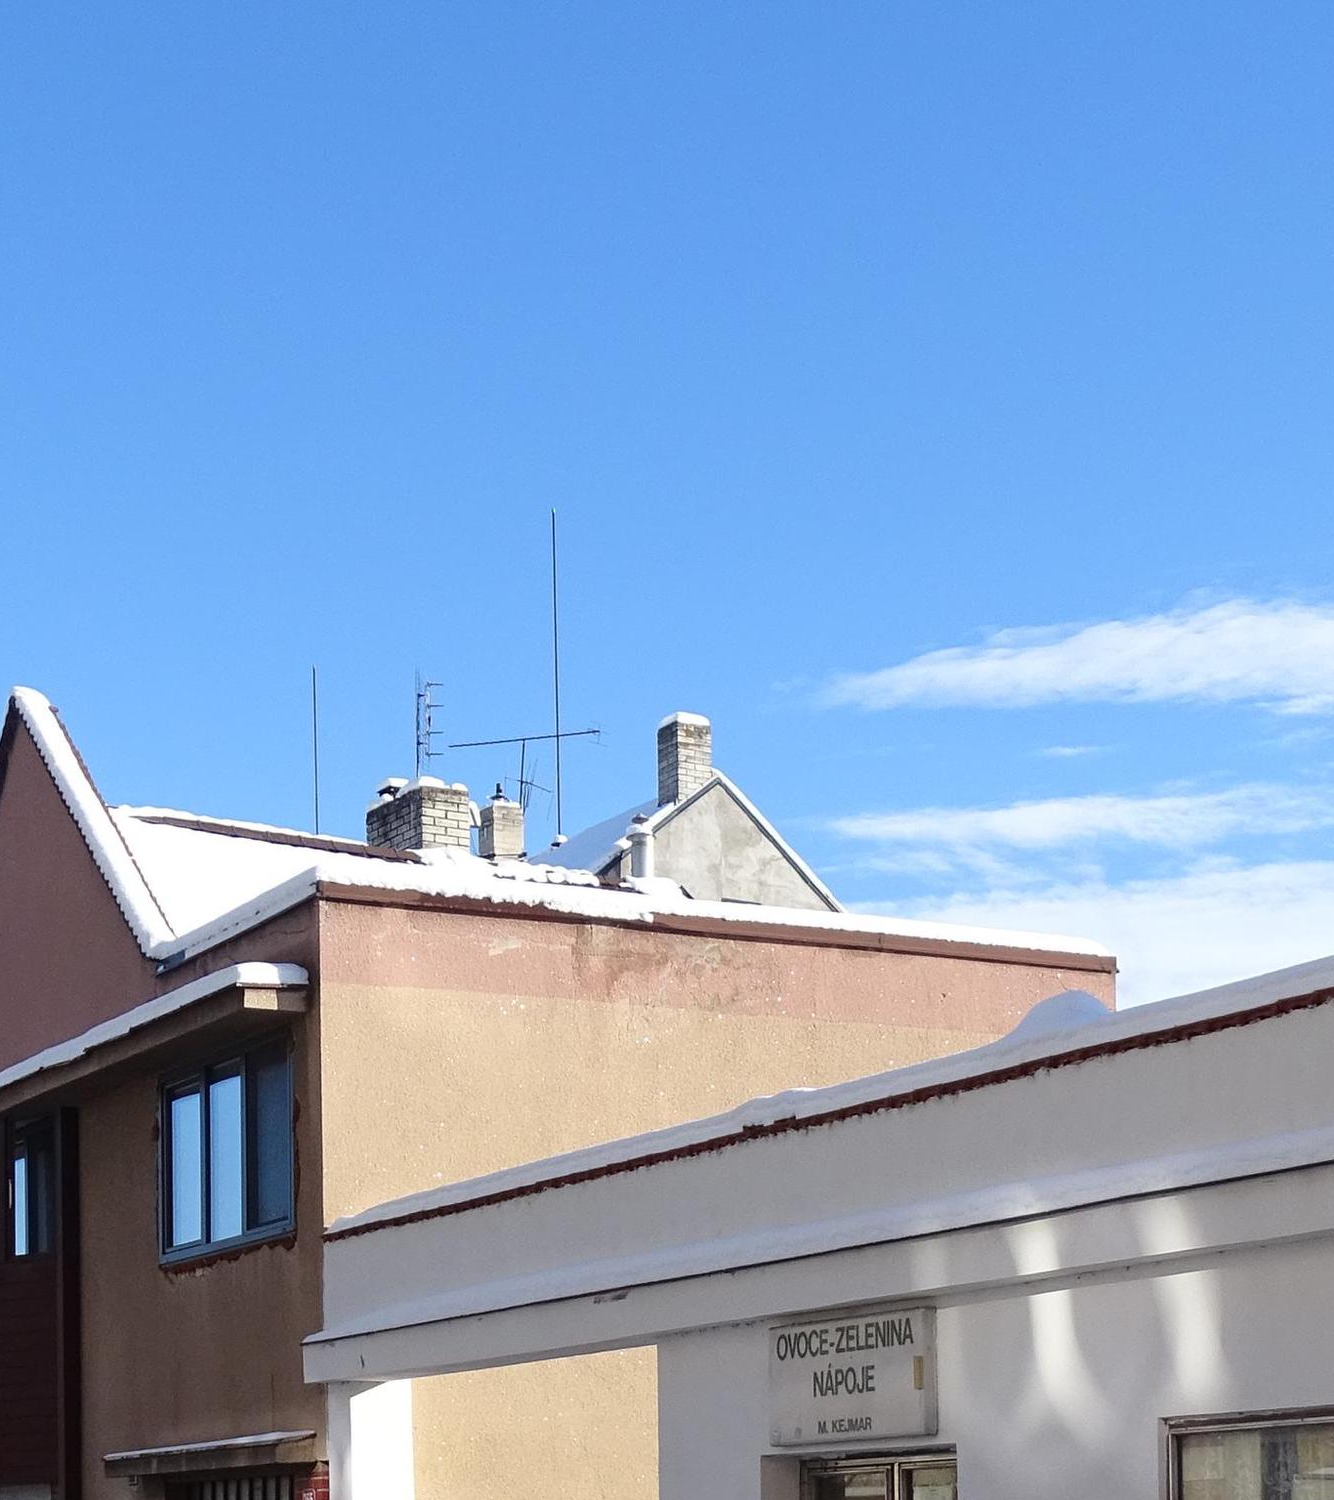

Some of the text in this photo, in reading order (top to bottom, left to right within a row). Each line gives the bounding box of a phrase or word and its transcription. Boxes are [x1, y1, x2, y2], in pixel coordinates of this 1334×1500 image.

[776, 1317, 914, 1361] OVOCE-ZELENINA
[813, 1363, 876, 1397] NÁPOJE
[817, 1417, 872, 1435] M. KEJMAR
